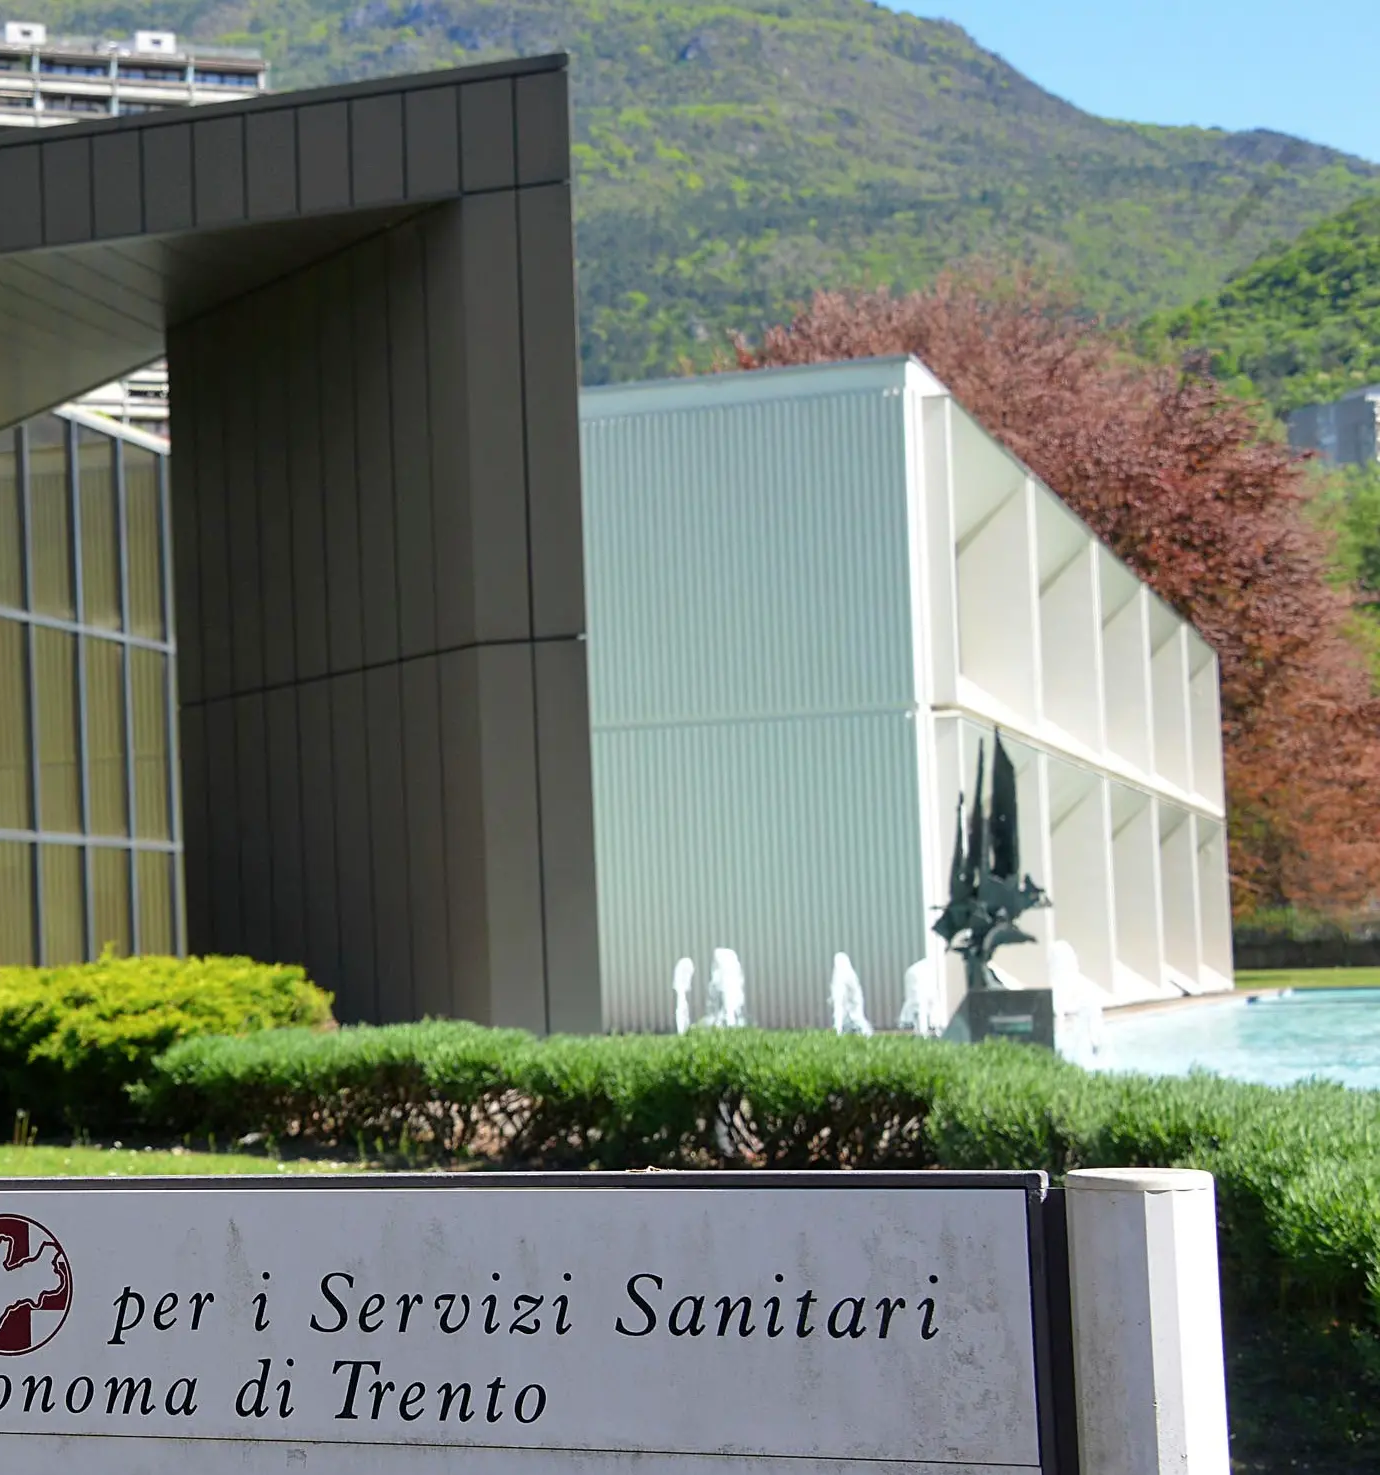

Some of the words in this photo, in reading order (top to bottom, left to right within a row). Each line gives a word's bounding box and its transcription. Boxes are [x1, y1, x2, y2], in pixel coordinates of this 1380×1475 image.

[105, 1286, 215, 1345] per
[250, 1270, 272, 1333] i
[309, 1271, 573, 1336] Servizi
[615, 1273, 940, 1341] Sanitari
[234, 1357, 296, 1419] di
[332, 1360, 548, 1424] Trento
